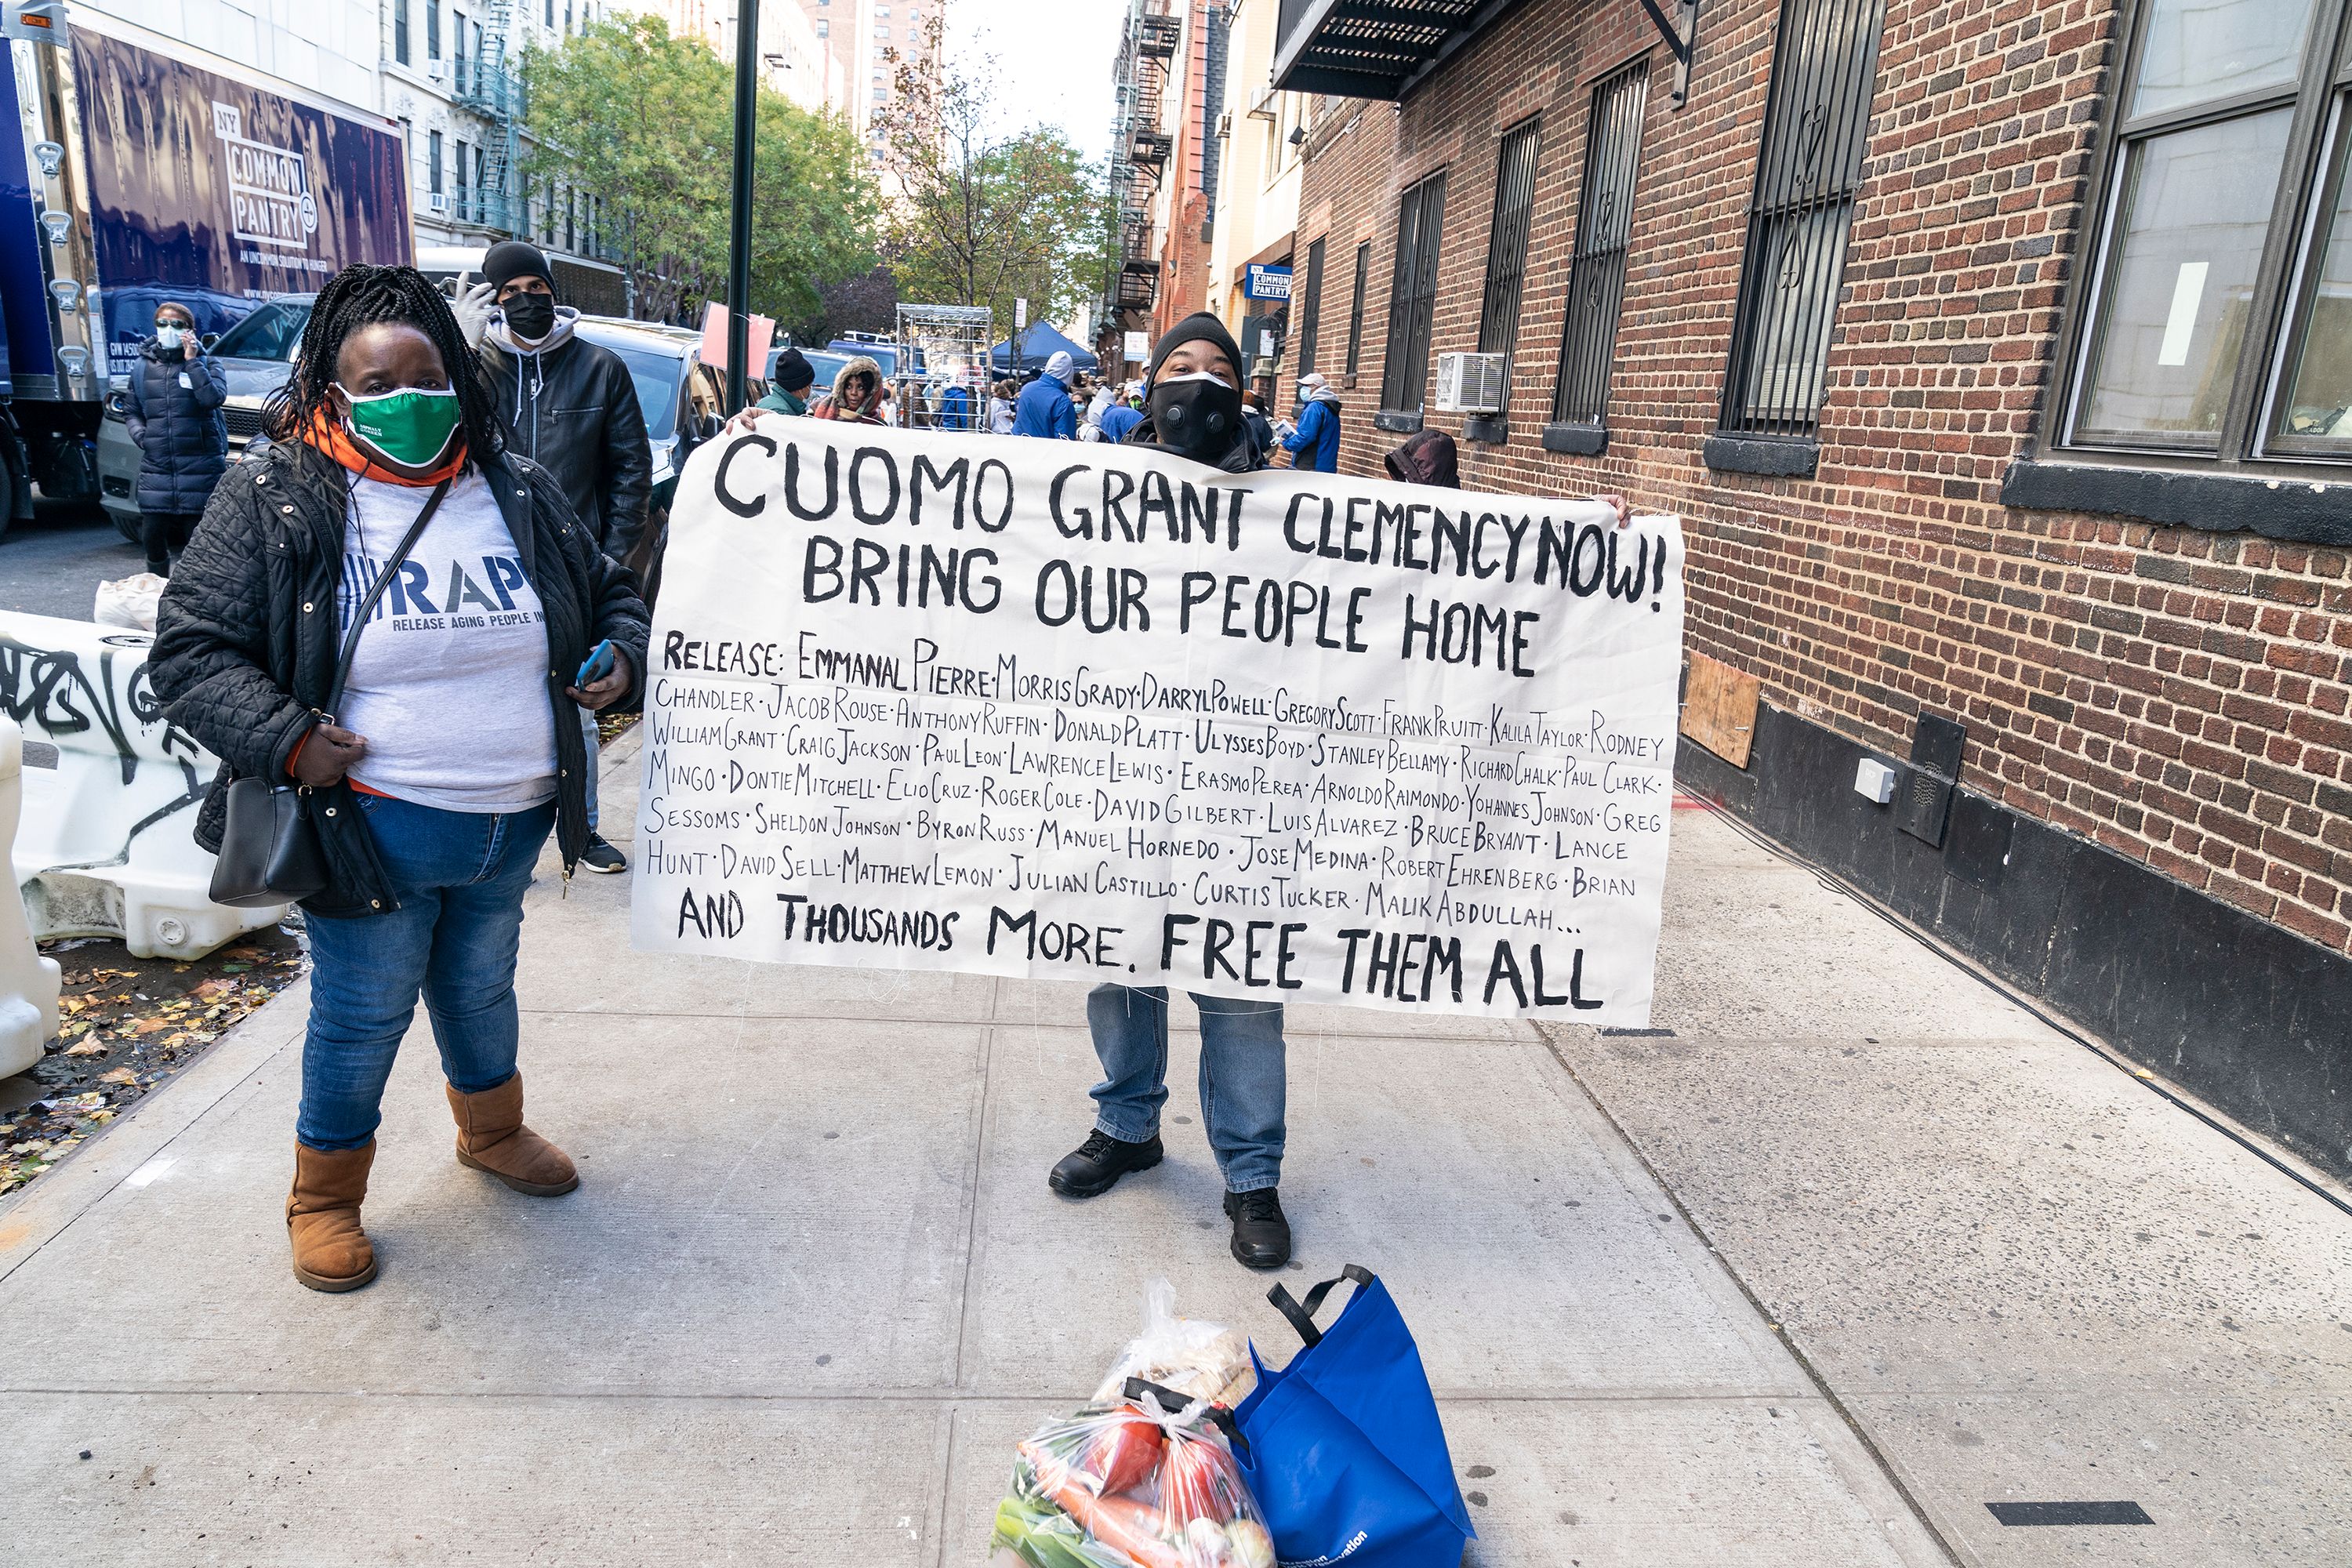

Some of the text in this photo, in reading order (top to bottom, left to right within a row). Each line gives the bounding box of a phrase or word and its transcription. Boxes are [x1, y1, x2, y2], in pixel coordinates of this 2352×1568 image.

[217, 110, 237, 133] NY
[230, 145, 300, 194] COMMON
[236, 195, 299, 239] PANTRY
[240, 249, 328, 273] AN UNCOMMON SOLUTION TO HUNGER
[1255, 285, 1287, 296] PANTRY
[1256, 274, 1290, 285] COMMON
[714, 434, 1665, 613] CUOMO GRANT CLEMENCY NOW!
[383, 556, 534, 615] RAP
[393, 617, 445, 631] RELEASE
[452, 615, 485, 630] AGING
[490, 612, 531, 626] PEOPLE
[804, 535, 1541, 678] BRING OUR PEOPLE HOME
[664, 630, 1664, 761] RELEASE: EMMANAL PIERRE MORRIS GRADY DARRYL POWELL GREGORY SCOTT FRANK PRUITT KALILA TAYLOR RODNEY
[652, 711, 1661, 833] WILLIAM GRANT CRAIG JACKSON PAUL LEON LAWRENCE LEWIS ERASMO PEREA ARNOLDO RAIMONDO YOHANNES JOHNSON GREG
[655, 679, 1657, 794] CHANDLER JACOB ROUSE ANTHONY RUFFIN DONALD PLATT ULYSSES BOYD STANLEY BELLAMY RICHARD CHALK PAUL CLARK
[648, 749, 1628, 860] MINGO DONTIE MITCHELL ELIO CRUZ ROGER COLE DAVID GILBERT LUIS ALVAREZ BRUCE BRYANT LANCE
[644, 797, 1635, 898] SESSOMS SHELDON JOHNSON BYRON RUSS MANUEL HORNEDO JOSE MEDINA ROBERT EHRENBERG BRIAN
[648, 840, 709, 876] HUNT
[721, 844, 775, 879] DAVID
[781, 845, 835, 880] SELL
[841, 846, 931, 885] MATTHEW
[934, 853, 993, 887] LEMON
[1009, 853, 1087, 893] JULIAN
[1095, 860, 1178, 898] CASTILLO
[1193, 872, 1270, 907] CURTIS
[1272, 877, 1350, 909] TUCKER
[1366, 881, 1432, 918] MALIK
[678, 887, 1604, 1010] AND THOUSANDS MORE. FREE THEM ALL
